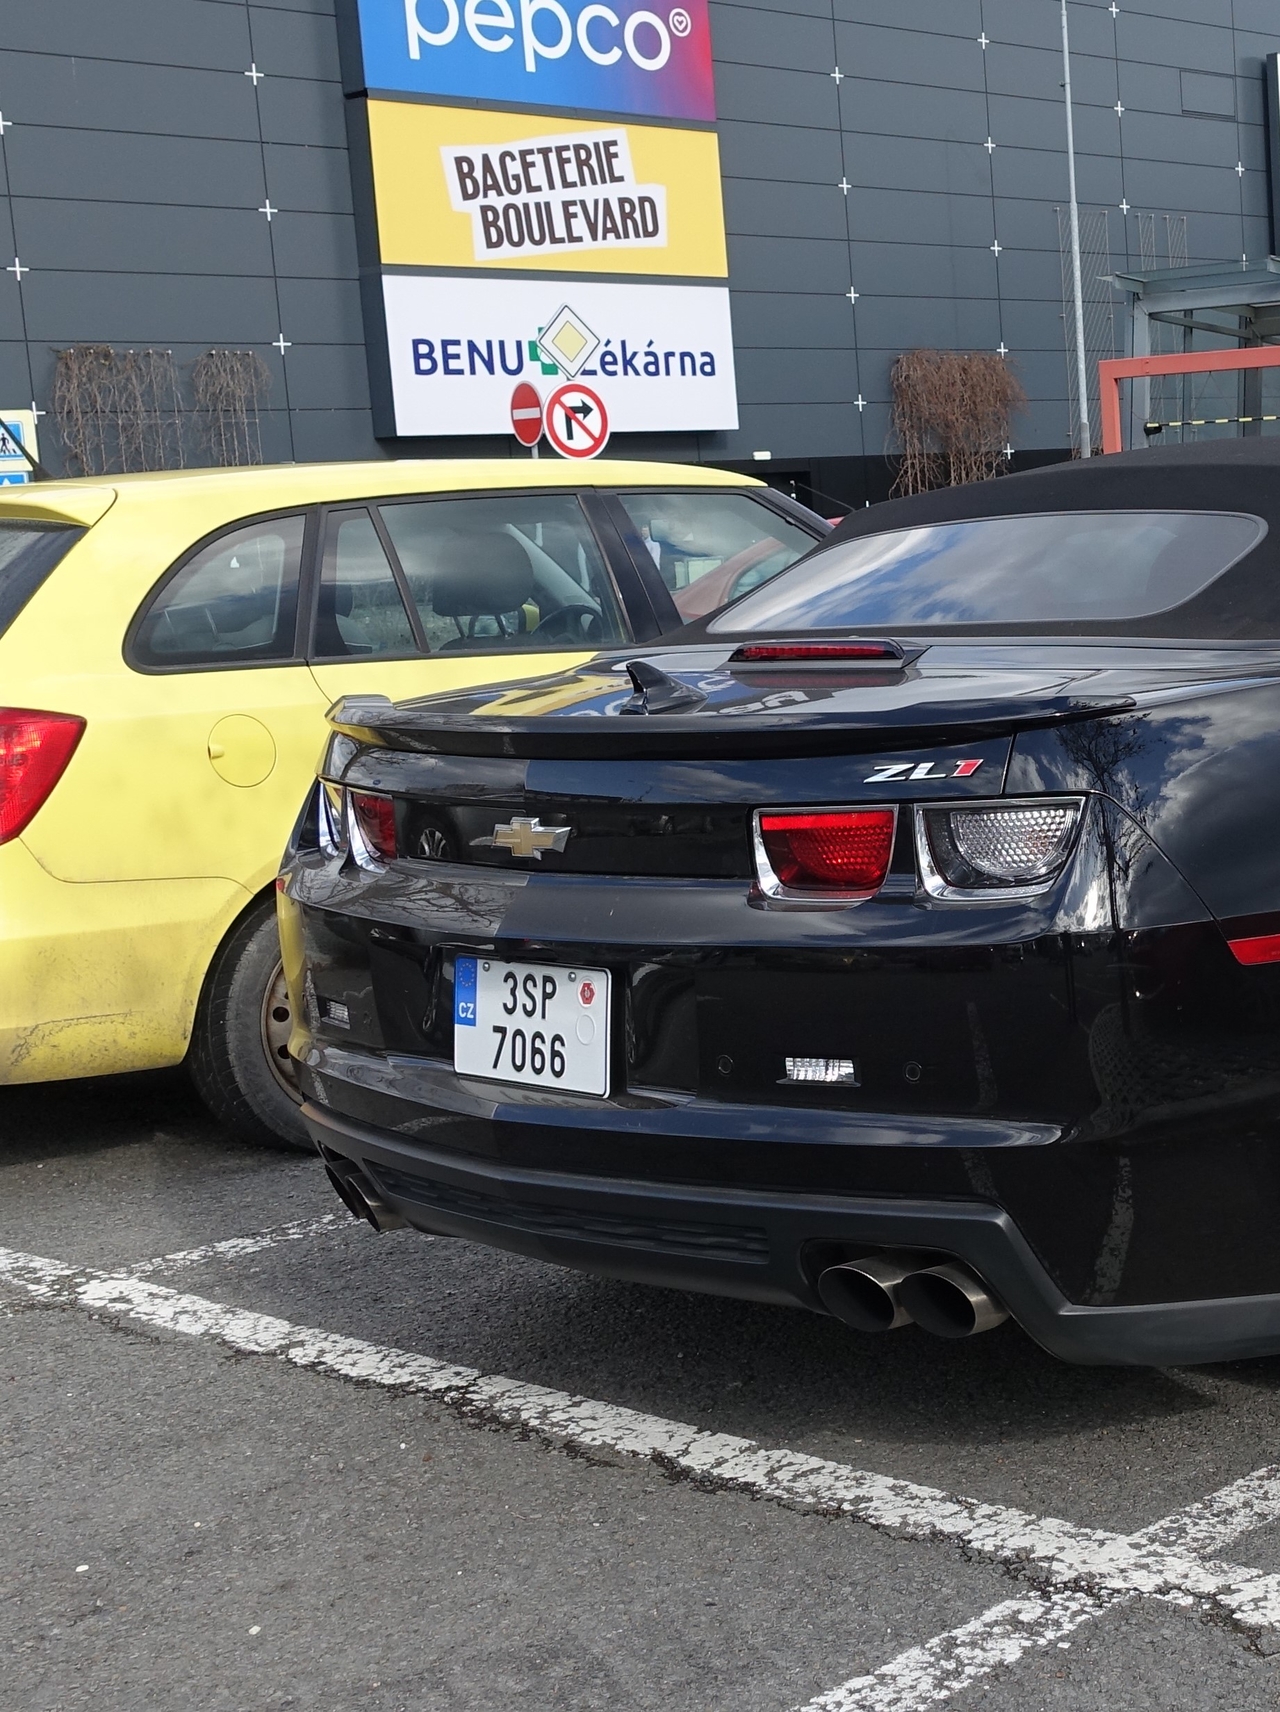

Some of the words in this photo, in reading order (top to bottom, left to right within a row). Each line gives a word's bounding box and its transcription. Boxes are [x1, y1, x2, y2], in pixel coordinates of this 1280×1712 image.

[404, 0, 671, 73] pepco
[453, 139, 625, 201] BAGETERIE
[479, 195, 660, 250] BOULEVARD
[411, 338, 524, 377] BENU
[863, 758, 984, 783] ZL1
[458, 1002, 474, 1019] CZ
[502, 971, 557, 1020] 3SP
[492, 1025, 566, 1078] 7066
